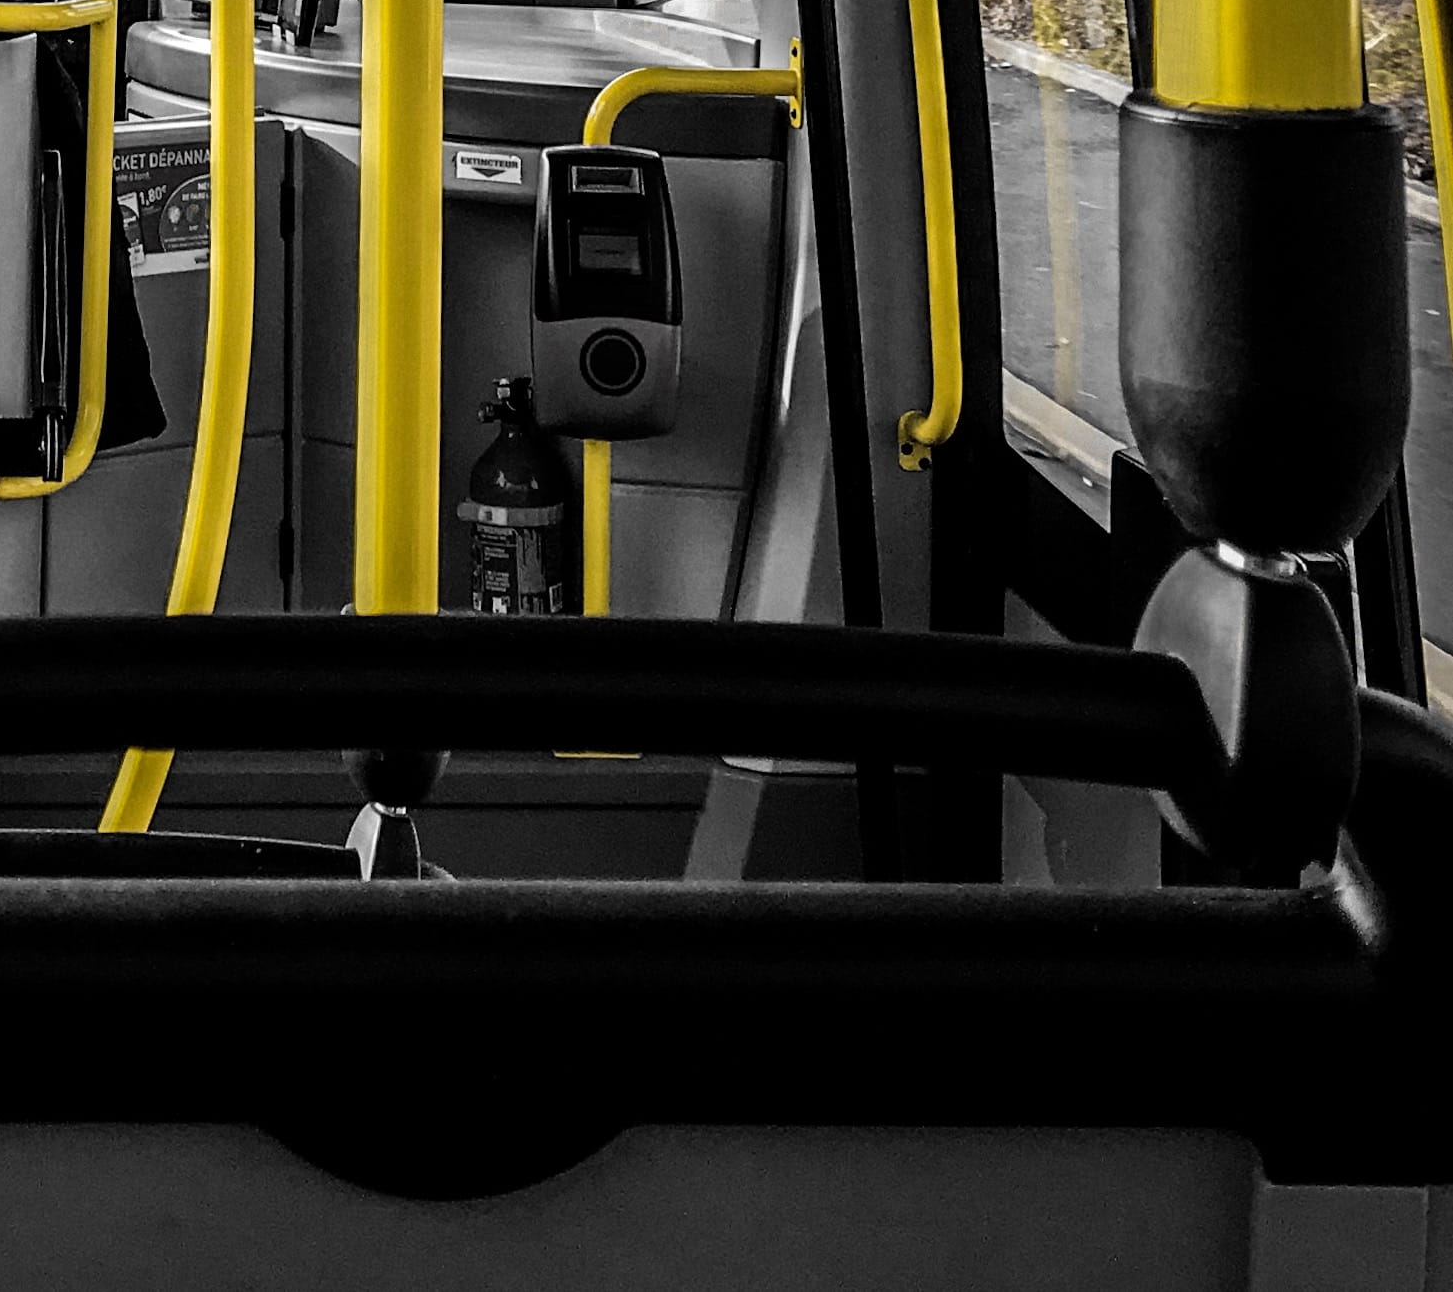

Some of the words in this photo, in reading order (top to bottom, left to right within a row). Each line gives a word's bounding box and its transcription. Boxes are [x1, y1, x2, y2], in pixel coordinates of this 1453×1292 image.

[113, 152, 146, 171] CKET
[149, 148, 210, 168] DÉPANNA
[461, 156, 519, 169] EXTINCTEUR
